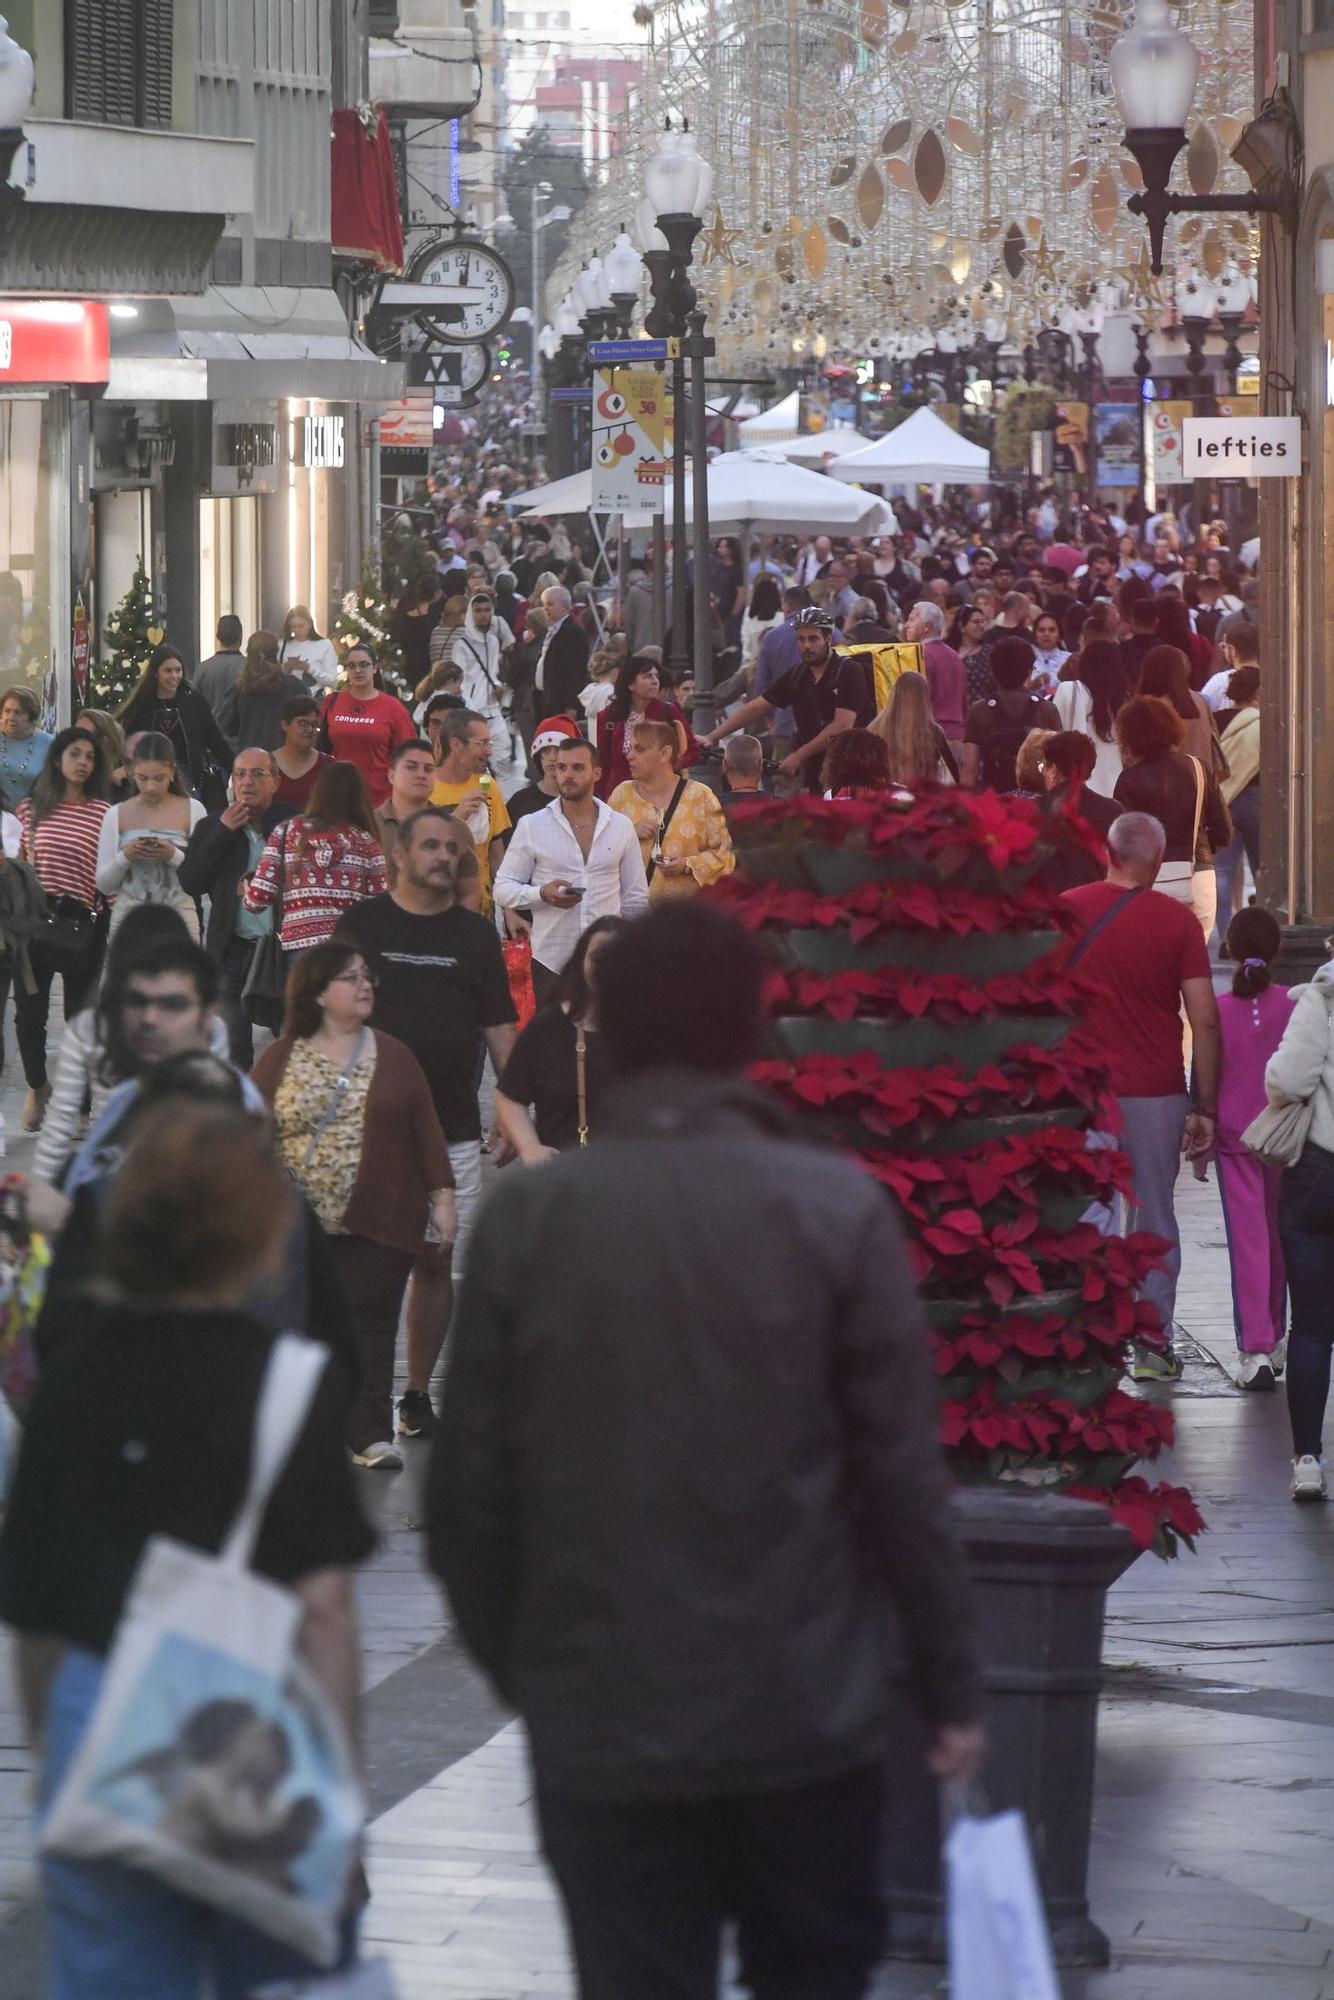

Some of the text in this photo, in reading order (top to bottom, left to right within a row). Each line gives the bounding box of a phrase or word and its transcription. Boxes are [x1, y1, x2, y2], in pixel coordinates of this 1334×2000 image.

[485, 270, 494, 282] 2
[490, 285, 499, 298] 3
[486, 303, 494, 313] 4
[475, 313, 483, 326] 5
[1197, 435, 1287, 457] lefties
